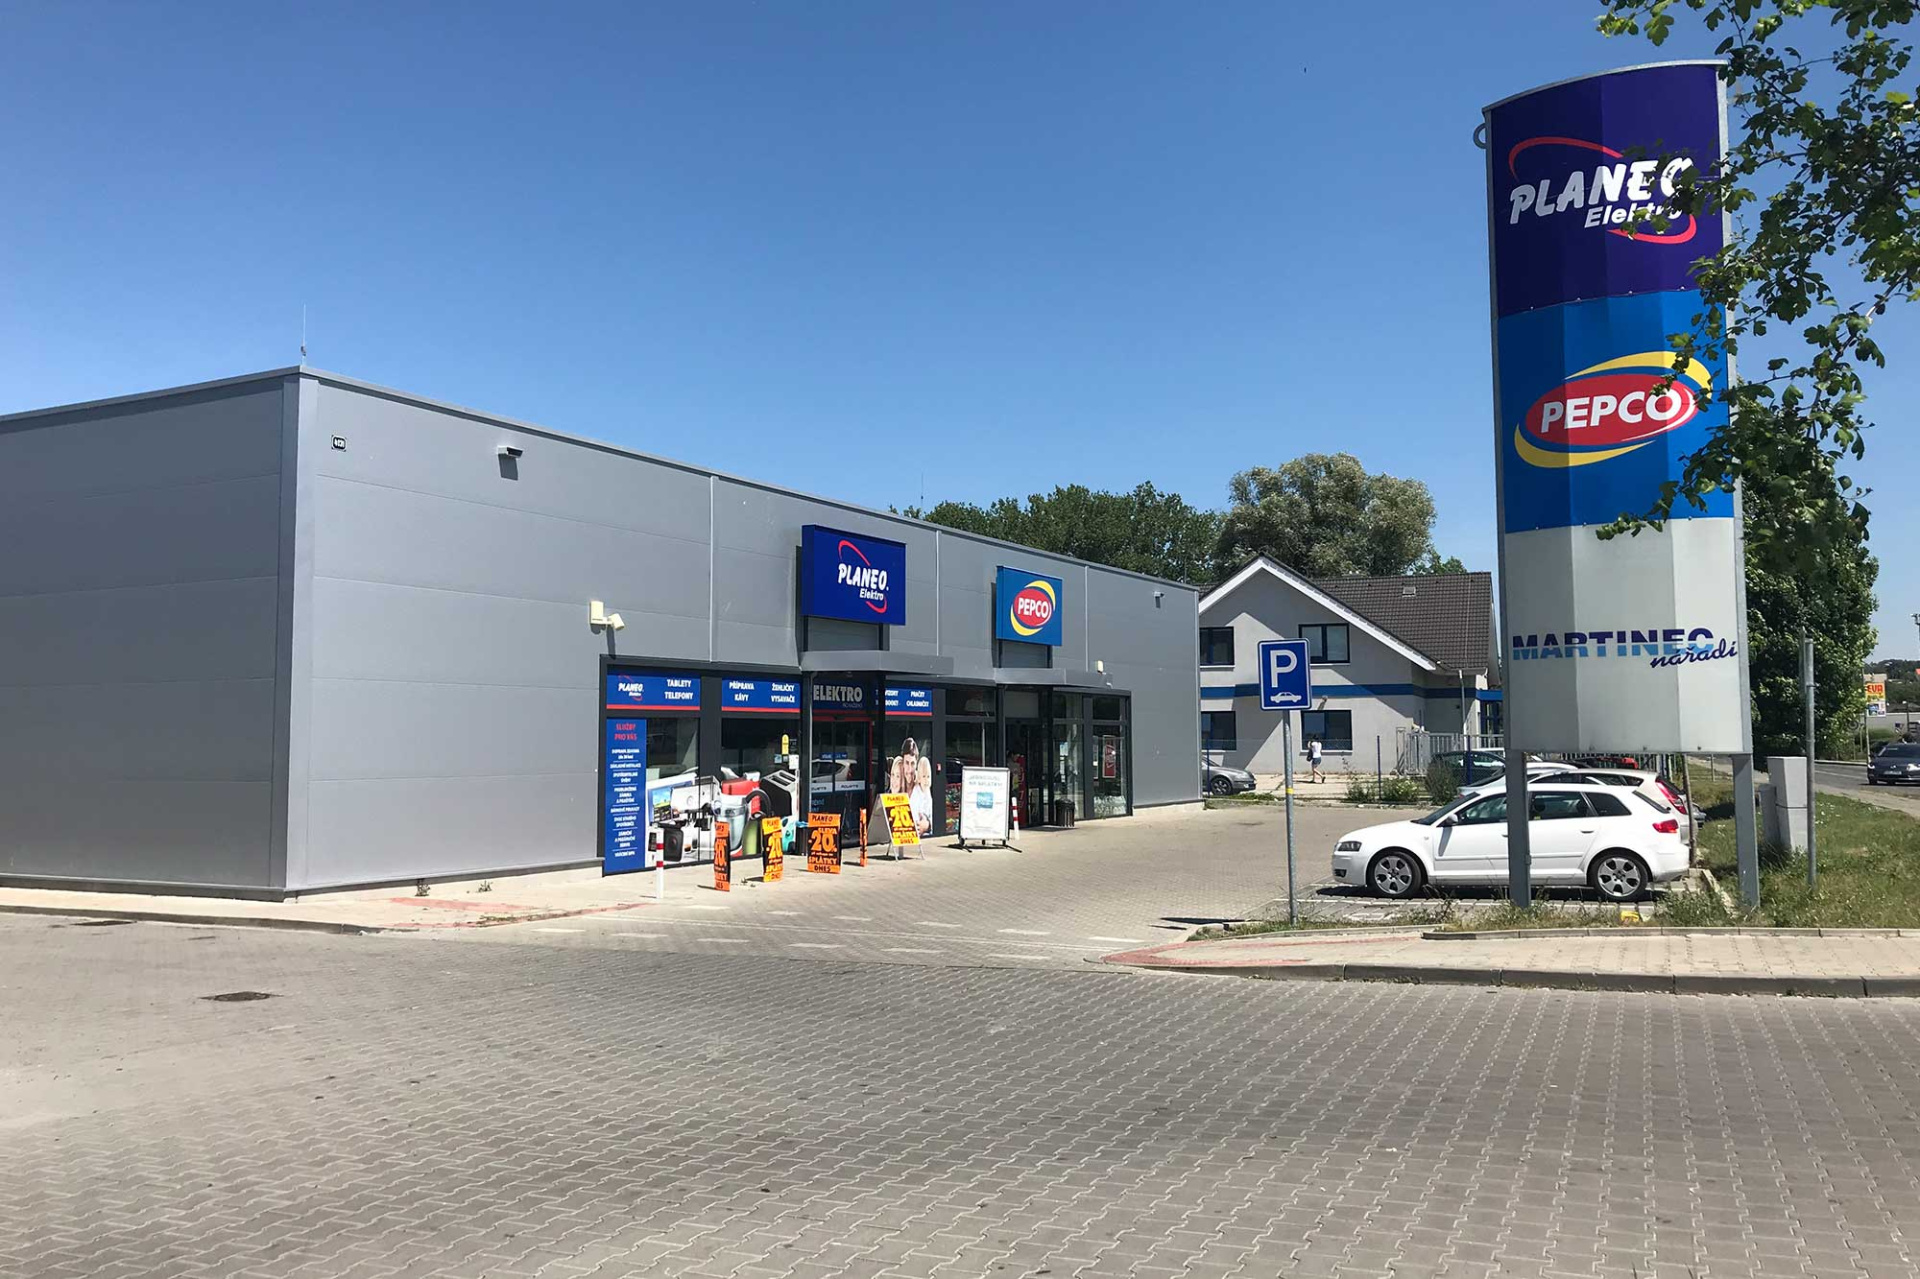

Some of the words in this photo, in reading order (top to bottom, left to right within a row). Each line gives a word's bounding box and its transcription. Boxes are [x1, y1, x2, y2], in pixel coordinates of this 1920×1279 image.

[1541, 388, 1682, 433] PEPCO
[838, 563, 887, 591] PLANEO
[860, 588, 884, 601] Elektro
[1017, 597, 1049, 619] PEPCO
[1512, 627, 1714, 660] MARTINEC
[1650, 638, 1738, 668] nářadí
[1270, 650, 1298, 688] P
[667, 679, 692, 688] TABLETY
[665, 691, 694, 700] TELEFONY
[735, 693, 749, 702] KÁVY
[813, 685, 863, 702] ELEKTRO
[814, 865, 832, 873] DNES
